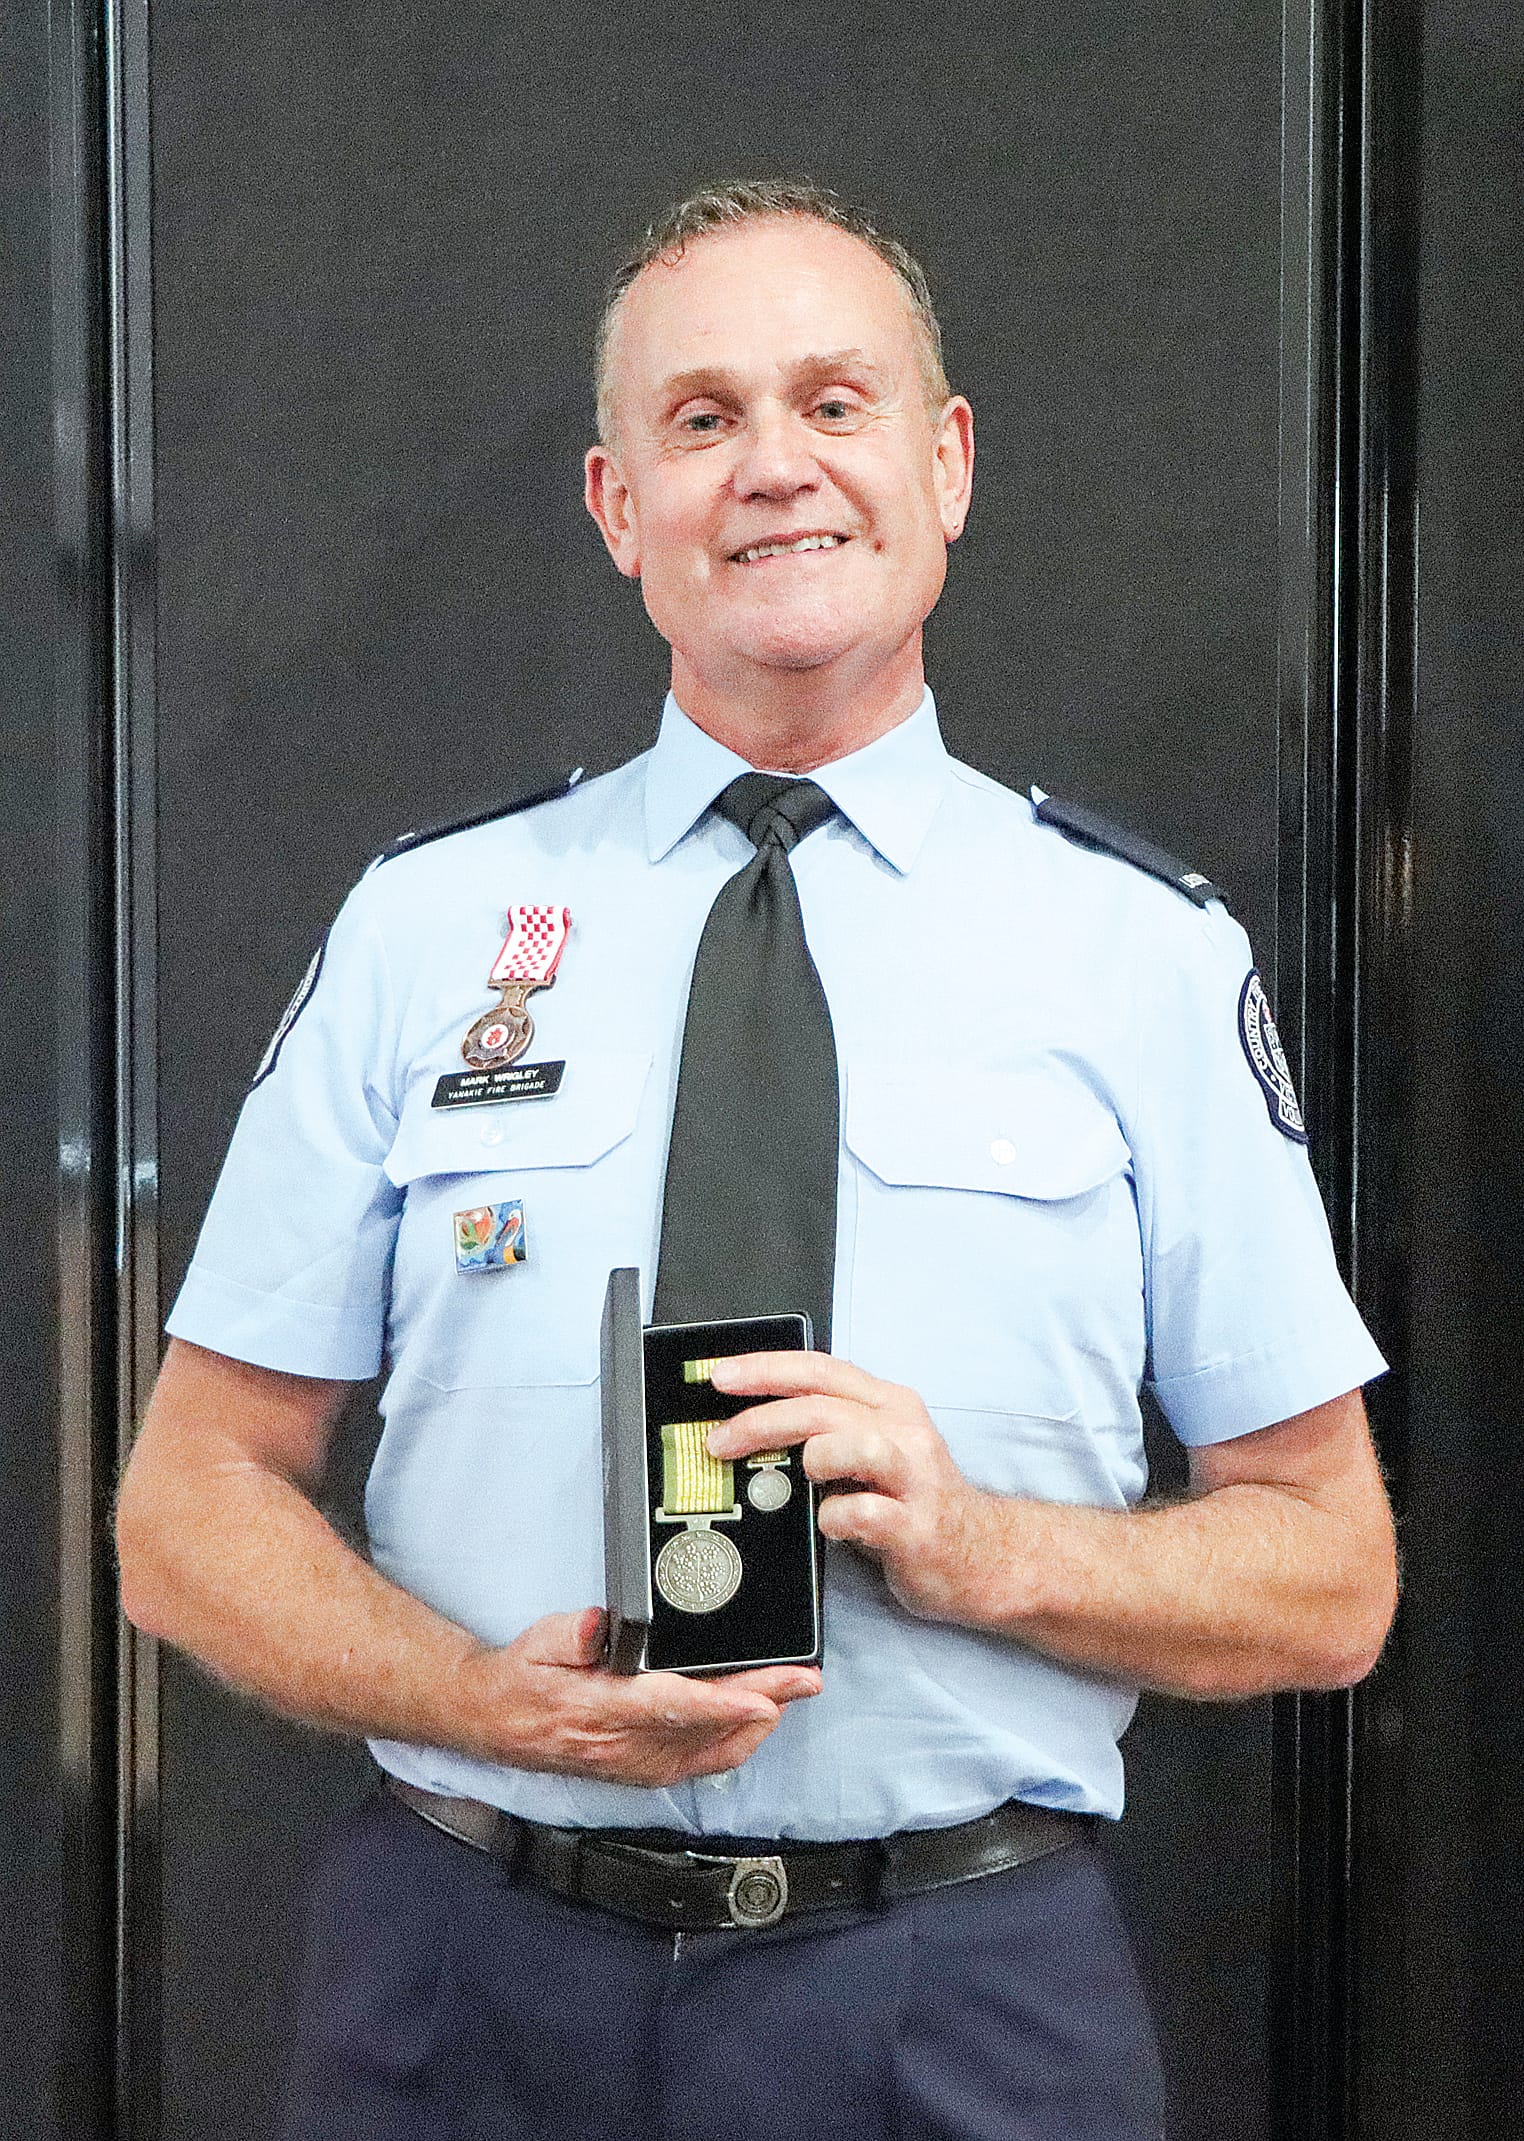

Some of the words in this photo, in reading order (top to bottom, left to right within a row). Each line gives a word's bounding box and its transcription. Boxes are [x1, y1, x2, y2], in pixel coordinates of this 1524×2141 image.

[1247, 999, 1268, 1070] COUNTRY
[460, 1075, 490, 1086] MARK
[494, 1069, 540, 1082] WRIGLEY
[448, 1088, 483, 1099] YANAKIE
[487, 1085, 506, 1094] FIRE
[509, 1081, 546, 1092] BRIGADE
